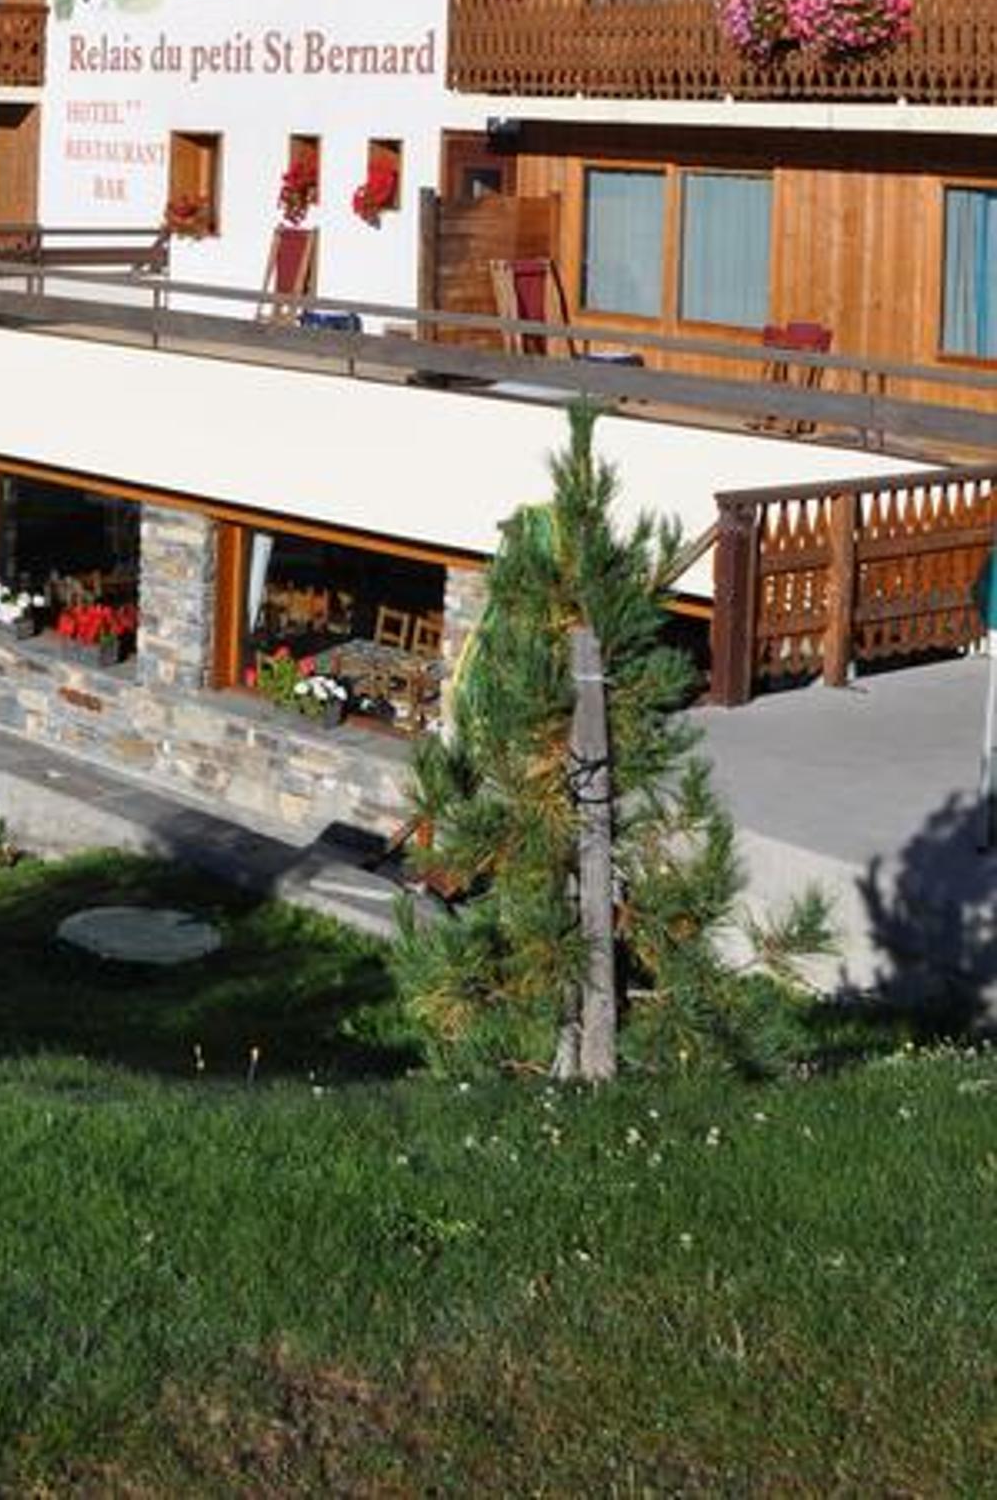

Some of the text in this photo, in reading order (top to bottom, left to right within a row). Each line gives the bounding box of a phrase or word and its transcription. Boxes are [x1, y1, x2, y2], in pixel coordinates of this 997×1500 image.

[69, 29, 435, 83] Relais du petit St Bernard
[65, 138, 164, 165] RESTAURANT
